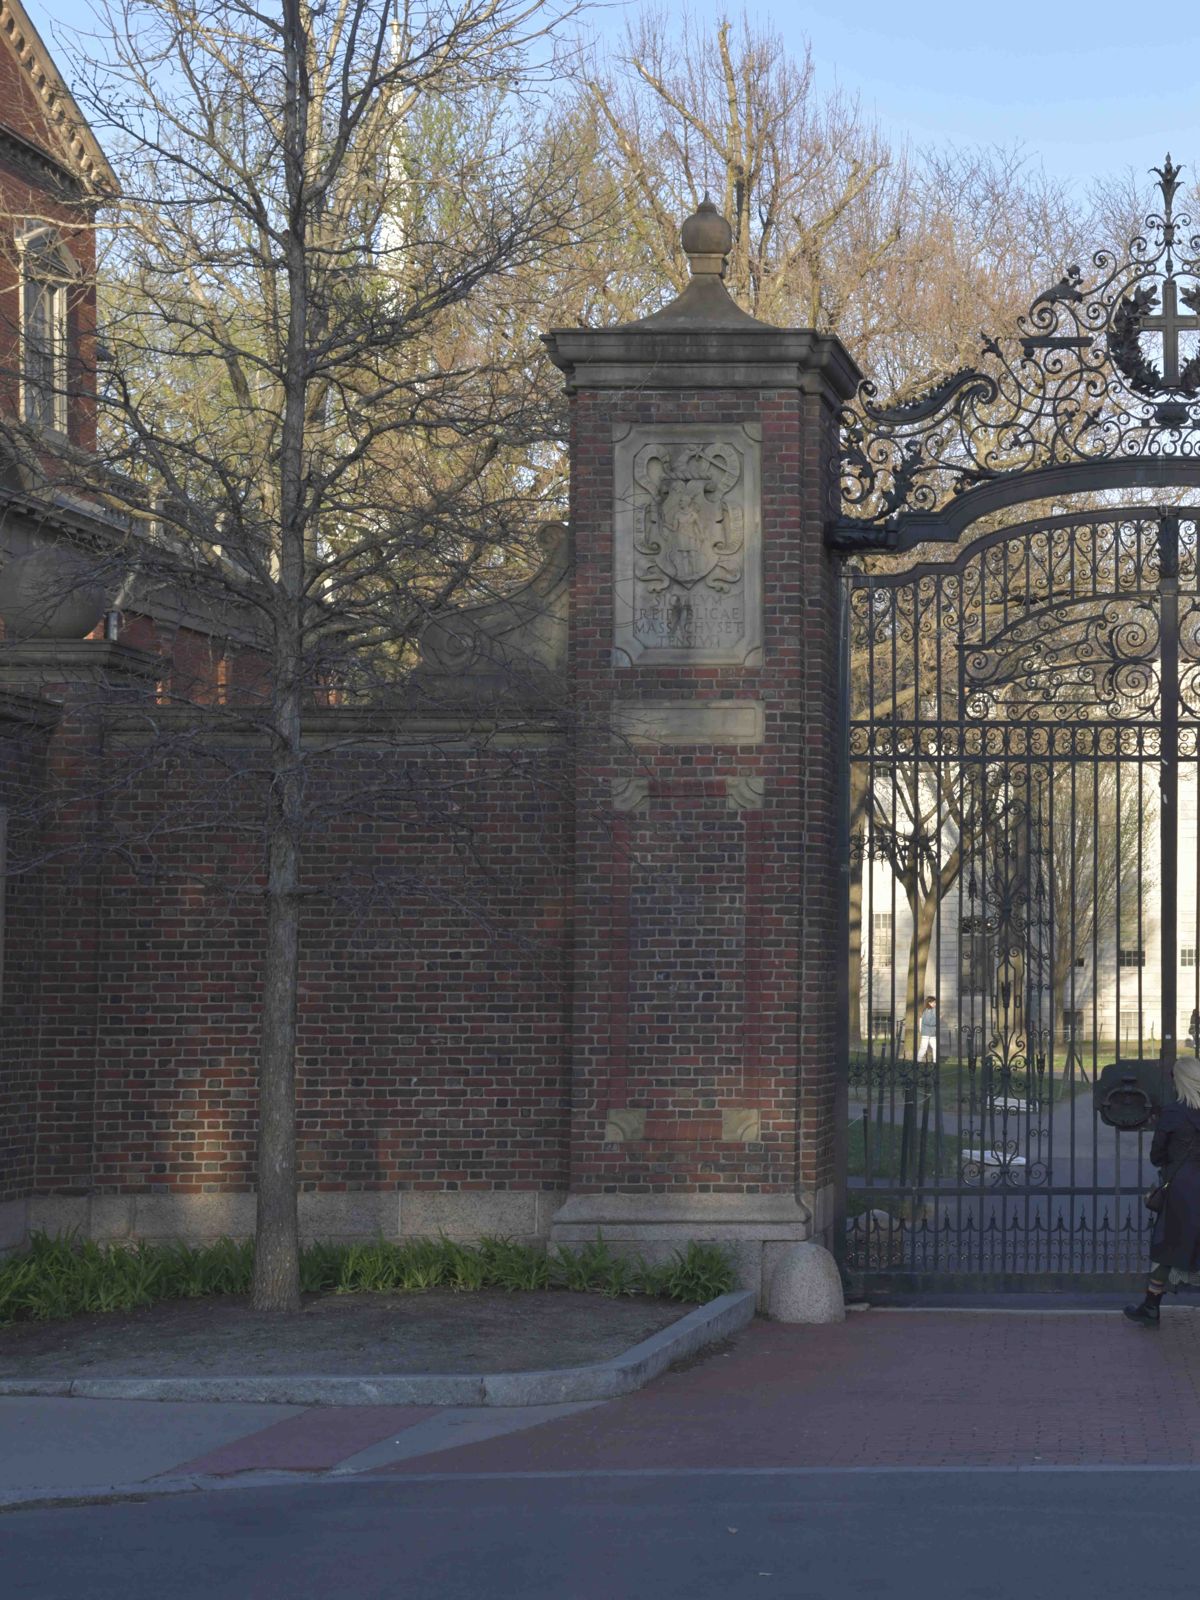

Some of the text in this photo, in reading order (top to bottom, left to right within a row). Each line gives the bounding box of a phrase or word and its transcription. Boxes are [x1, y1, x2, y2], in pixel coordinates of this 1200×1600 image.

[1138, 427, 1194, 456] 1636
[655, 593, 722, 606] SIGLVM
[639, 607, 739, 620] REIPBLICAE
[634, 622, 743, 634] MASSACHVSET
